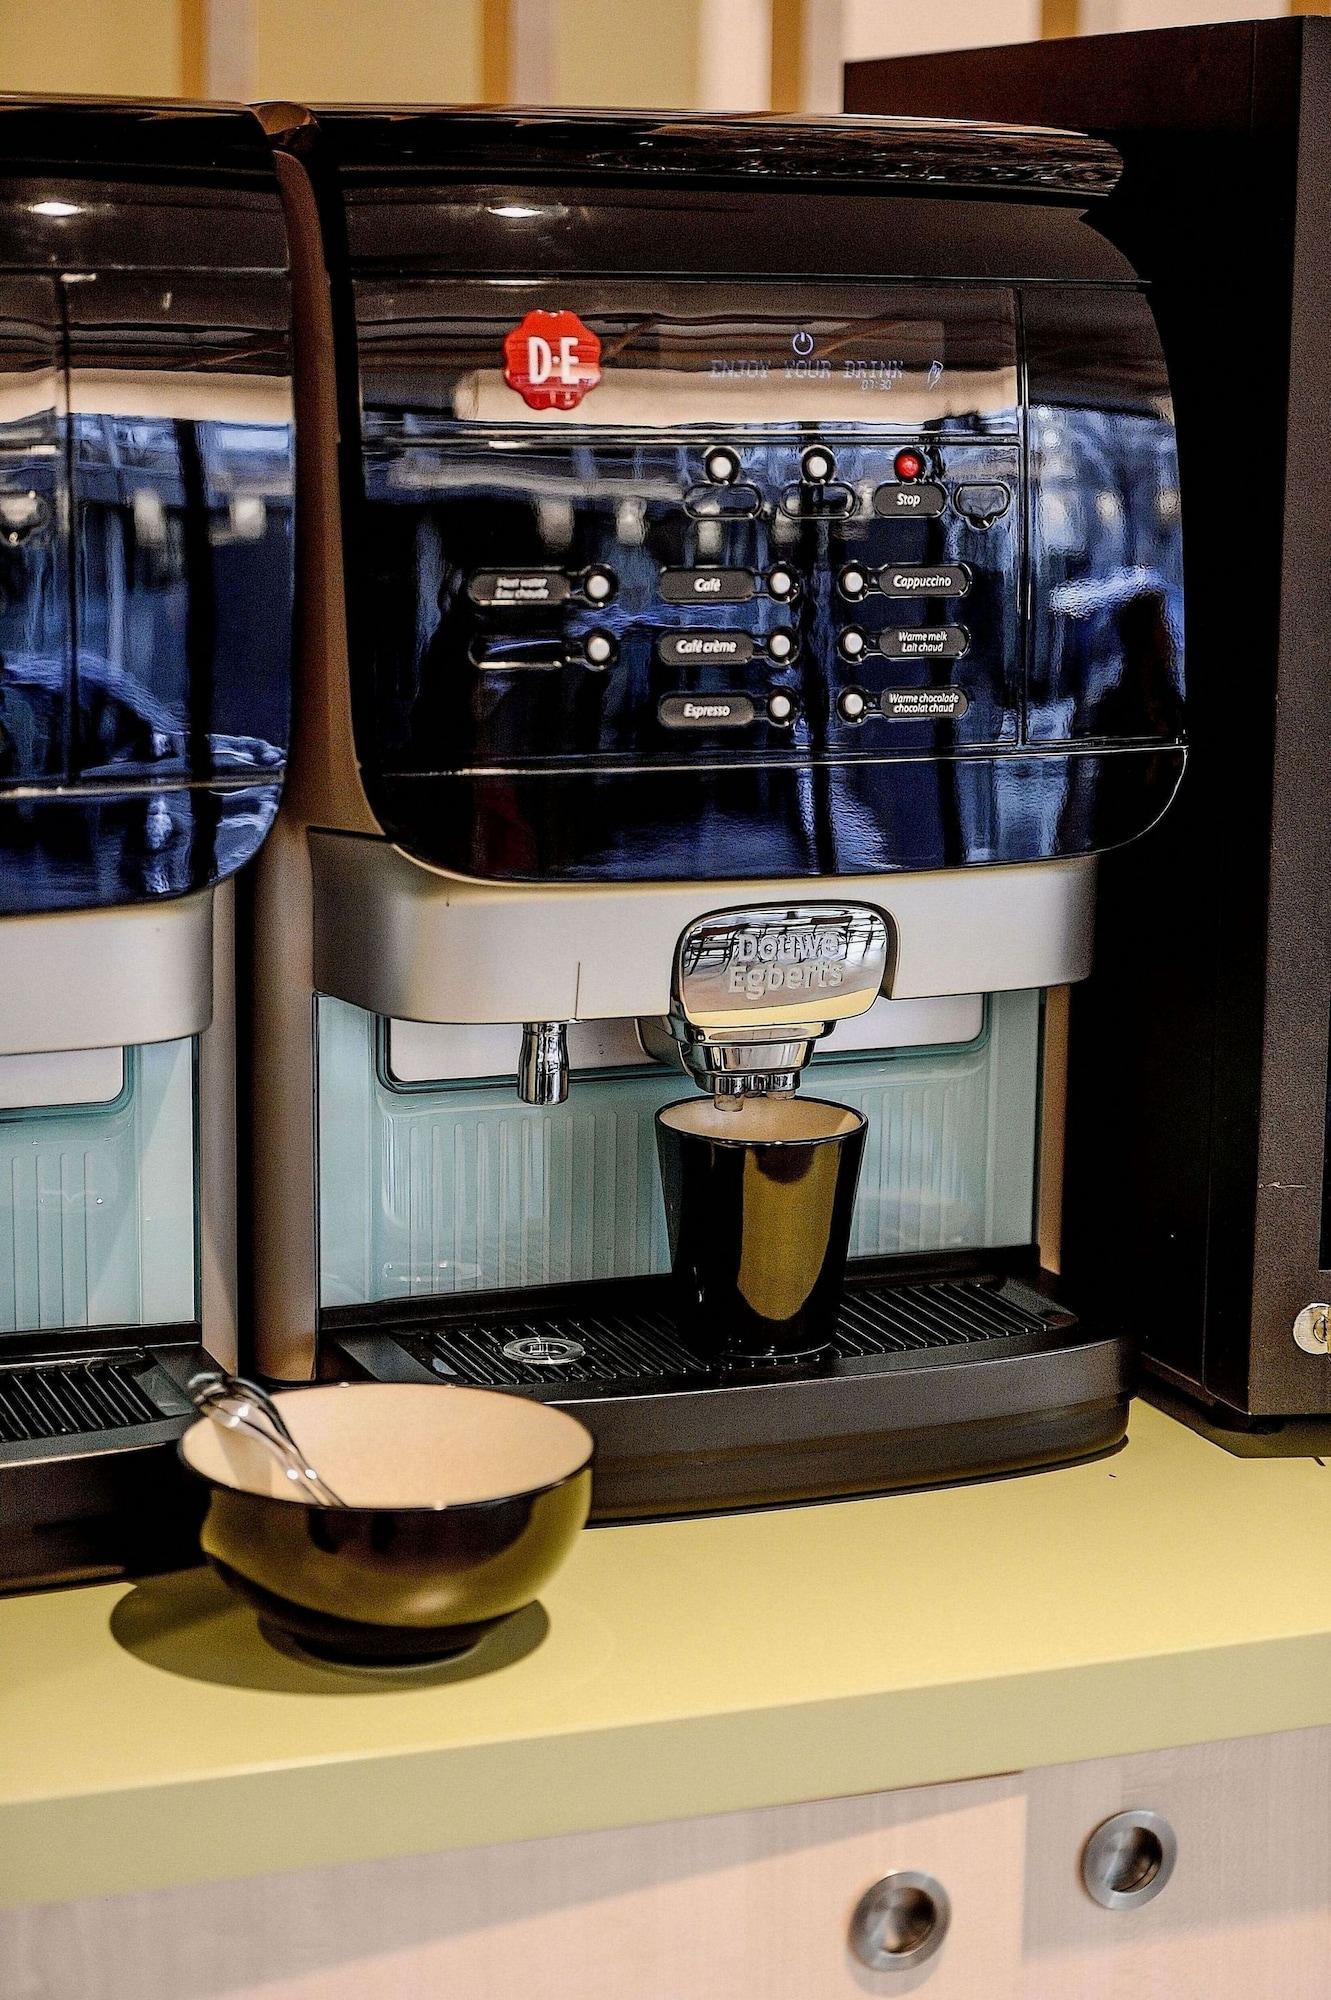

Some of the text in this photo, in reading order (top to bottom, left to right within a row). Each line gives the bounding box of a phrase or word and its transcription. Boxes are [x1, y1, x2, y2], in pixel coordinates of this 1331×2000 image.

[709, 359, 904, 379] ENJOY YOUR DRINK
[896, 492, 921, 507] Stop
[694, 577, 721, 592] Café
[893, 574, 952, 590] Cappuccino
[899, 630, 948, 641] Warme melk
[676, 638, 737, 654] Café crème
[902, 641, 944, 653] Lait chaud
[889, 692, 959, 704] Warme chocolade
[683, 702, 731, 719] Espresso
[894, 702, 954, 714] chocolat chaud
[738, 931, 840, 961] Douwe
[729, 962, 844, 1000] Egberts
